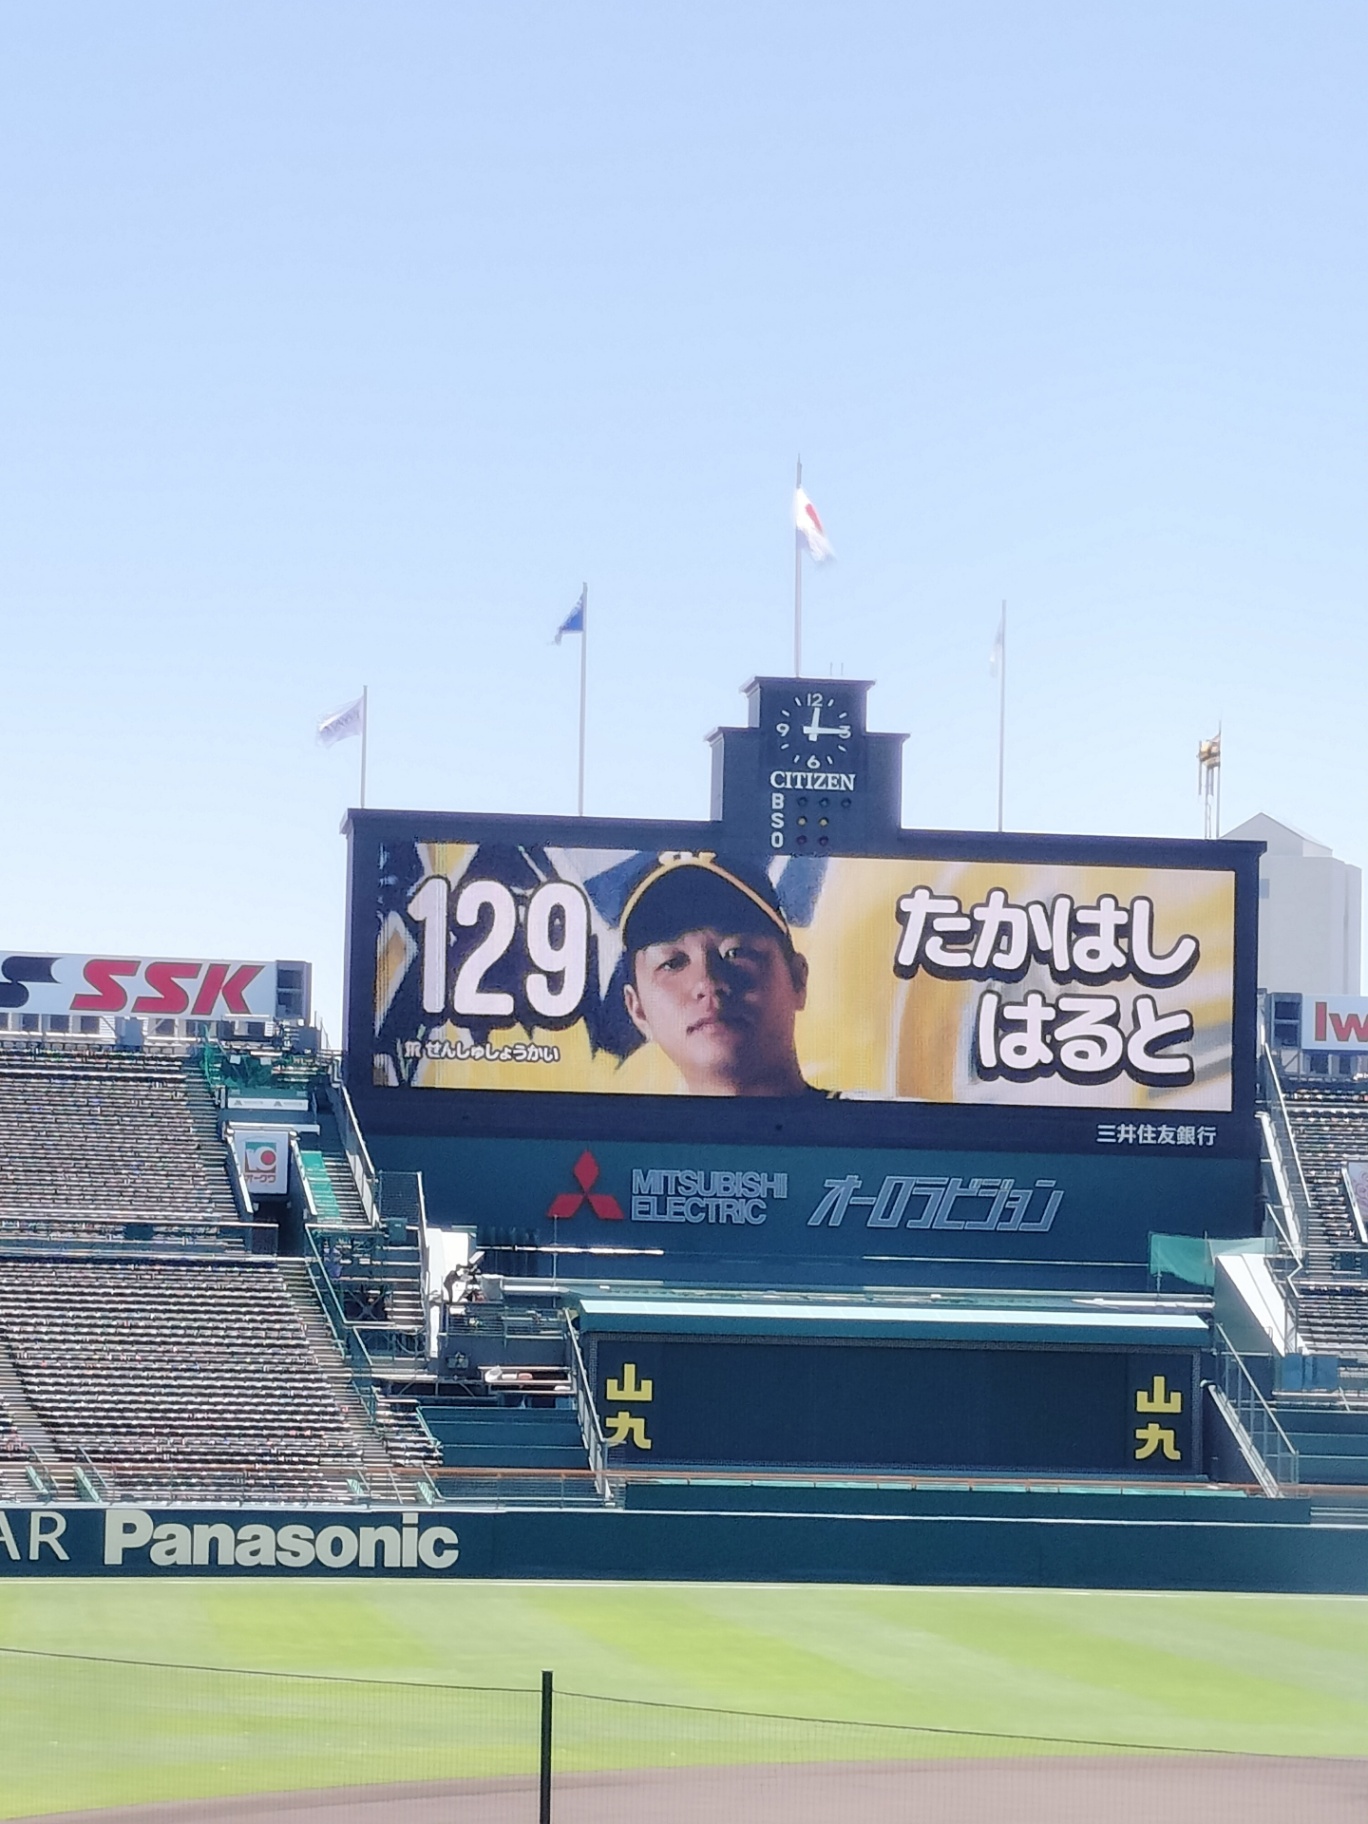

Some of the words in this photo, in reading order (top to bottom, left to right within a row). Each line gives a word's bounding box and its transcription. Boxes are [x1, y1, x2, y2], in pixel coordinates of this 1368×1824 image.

[807, 693, 823, 707] 12
[776, 723, 790, 737] 9
[807, 755, 820, 769] 6
[770, 770, 856, 791] CITIZEN
[772, 793, 784, 810] B
[771, 812, 784, 829] S
[771, 832, 784, 848] O
[407, 876, 590, 1018] 129
[896, 886, 1199, 980] たかはし
[69, 958, 266, 1016] SSK
[978, 991, 1196, 1078] はると
[424, 1040, 560, 1062] せんしゅしょうかい
[1096, 1124, 1217, 1147] 三井住友銀行
[631, 1169, 788, 1198] MITSUBISHI
[631, 1197, 767, 1225] ELECTRIC
[807, 1174, 1066, 1232] オーロラビジョン
[605, 1363, 653, 1450] 山九
[1135, 1375, 1183, 1461] 山九
[103, 1509, 460, 1569] Panasonic
